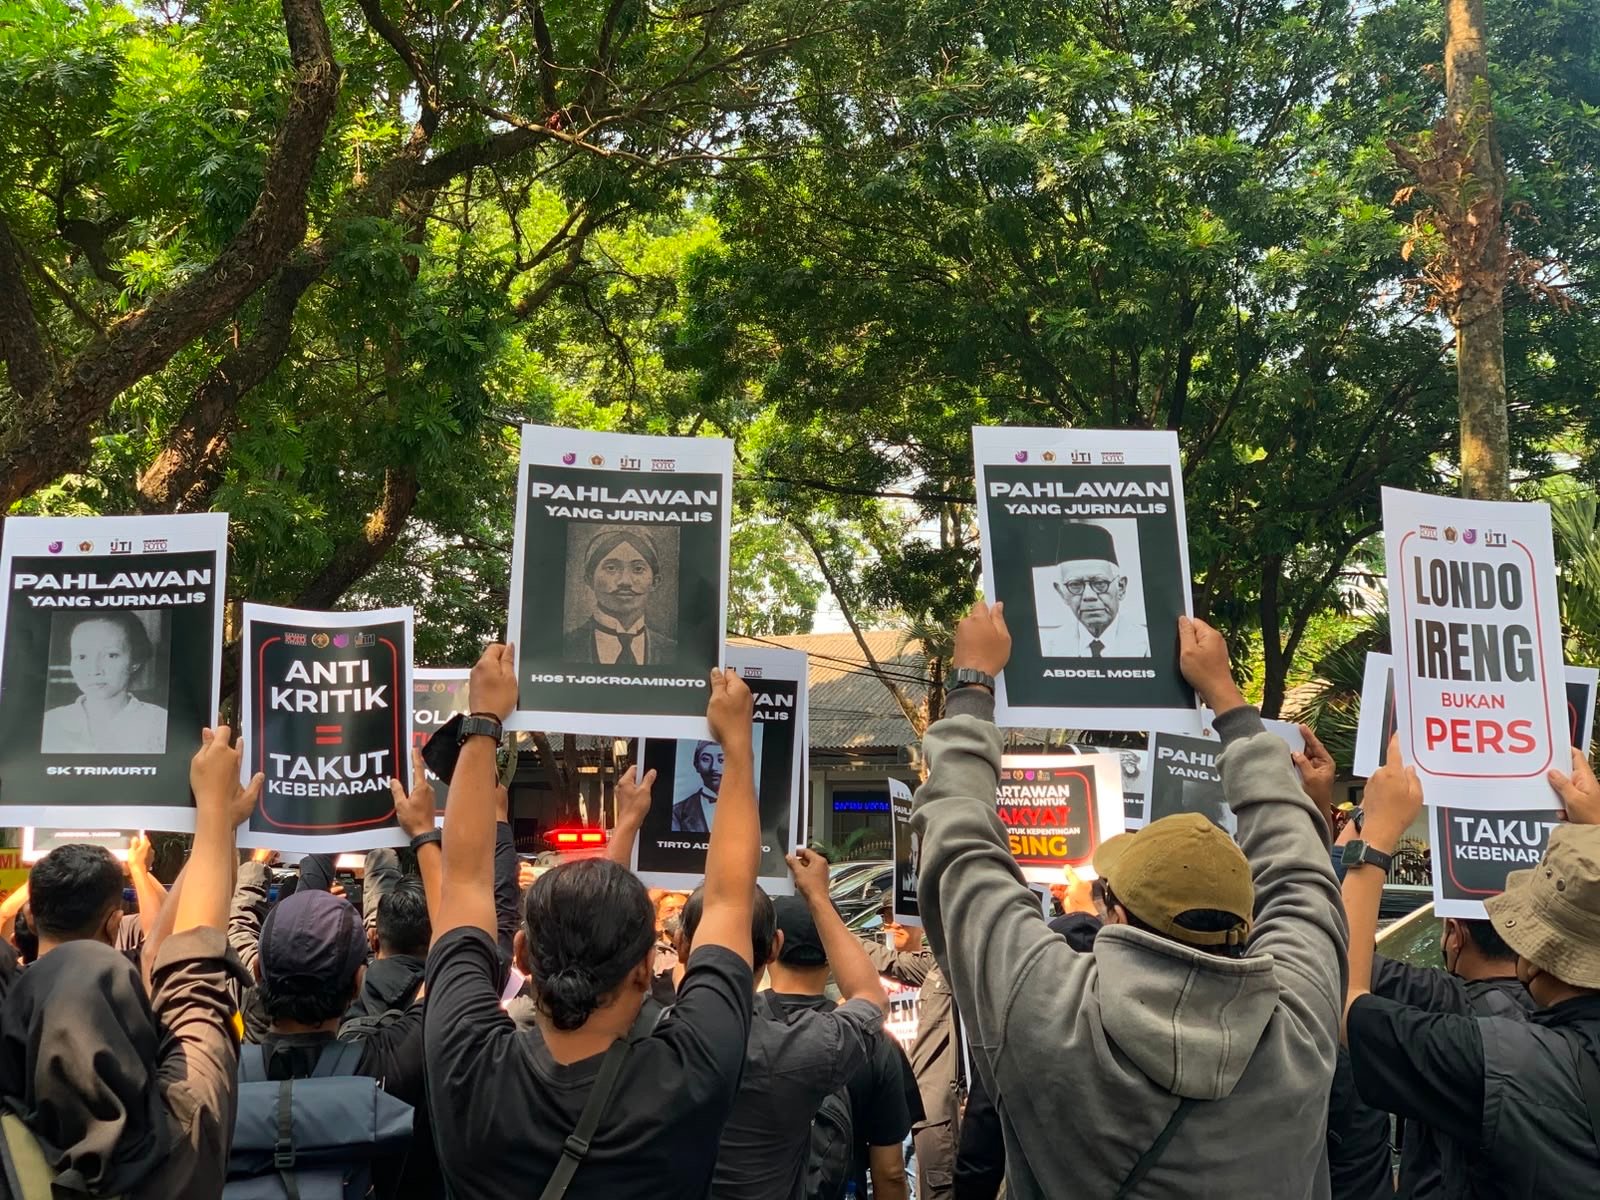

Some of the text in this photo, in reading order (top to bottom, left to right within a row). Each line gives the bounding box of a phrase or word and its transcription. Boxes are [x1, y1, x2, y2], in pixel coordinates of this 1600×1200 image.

[532, 482, 718, 506] PAHLAWAN
[989, 481, 1170, 498] PAHLAWAN
[545, 505, 713, 522] YANG JURNALIS
[1004, 503, 1167, 515] YANG JURNALIS
[14, 568, 212, 590] PAHLAWAN
[1413, 556, 1524, 611] LONDO
[28, 592, 206, 607] YANG JURNALIS
[1415, 618, 1536, 683] IRENG
[285, 659, 370, 684] ANTI
[531, 674, 706, 688] HOS TJOKROAMINOTO
[1042, 669, 1156, 678] ABDOEL MOEIS
[271, 685, 389, 714] KRITIK
[1441, 692, 1505, 710] BUKAN
[753, 710, 789, 721] ALIS
[1425, 716, 1537, 754] PERS
[269, 749, 390, 781] TAKUT
[1158, 746, 1216, 768] PAHL
[46, 766, 157, 776] SK TRIMURTI
[1166, 765, 1209, 780] YANG
[268, 775, 392, 797] KEBENARAN
[1032, 797, 1067, 806] UNTUK
[998, 806, 1072, 826] AKYAT
[656, 840, 710, 850] TIRTO AD
[1008, 835, 1068, 856] SING
